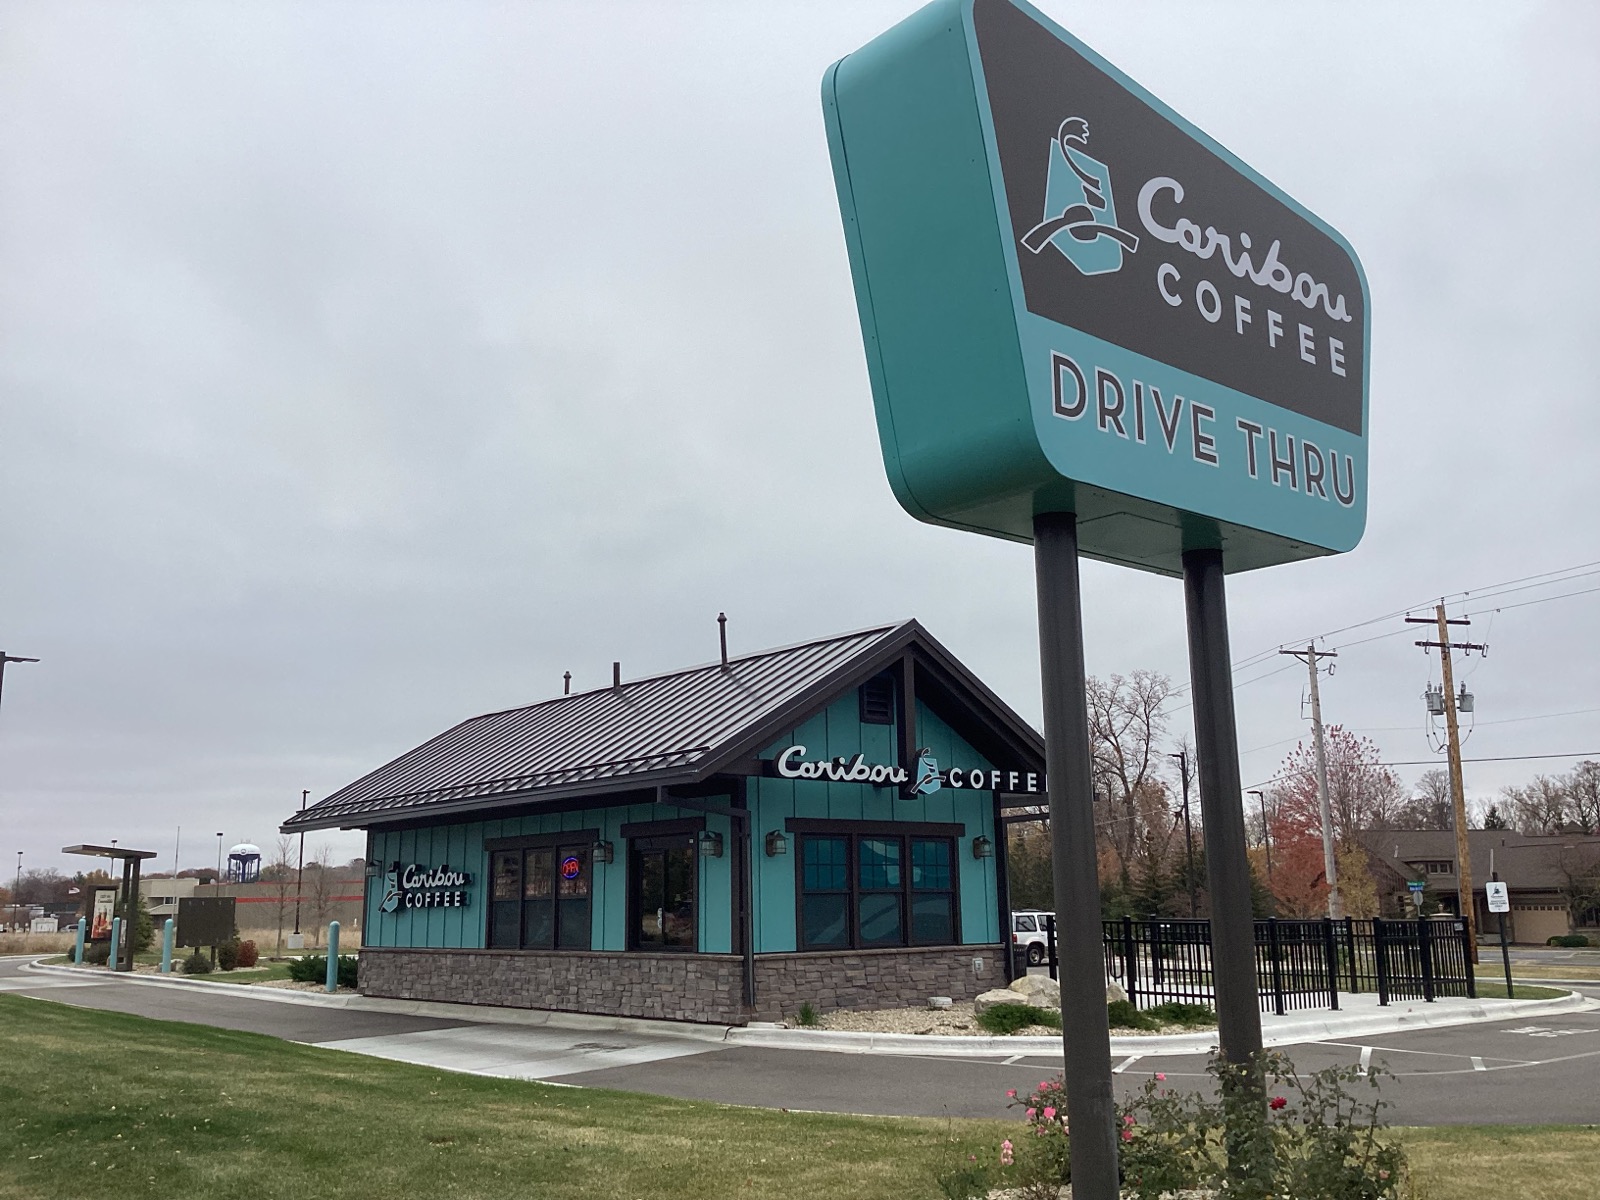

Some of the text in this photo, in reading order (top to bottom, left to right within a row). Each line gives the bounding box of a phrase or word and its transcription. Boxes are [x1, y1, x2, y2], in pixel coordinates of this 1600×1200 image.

[1138, 177, 1352, 322] Caribou
[1158, 263, 1346, 377] COFFEE
[1050, 349, 1356, 508] DRIVE THRU
[778, 745, 1048, 792] Caribou COFFE
[403, 864, 464, 889] Caribou
[405, 891, 461, 908] COFFEE
